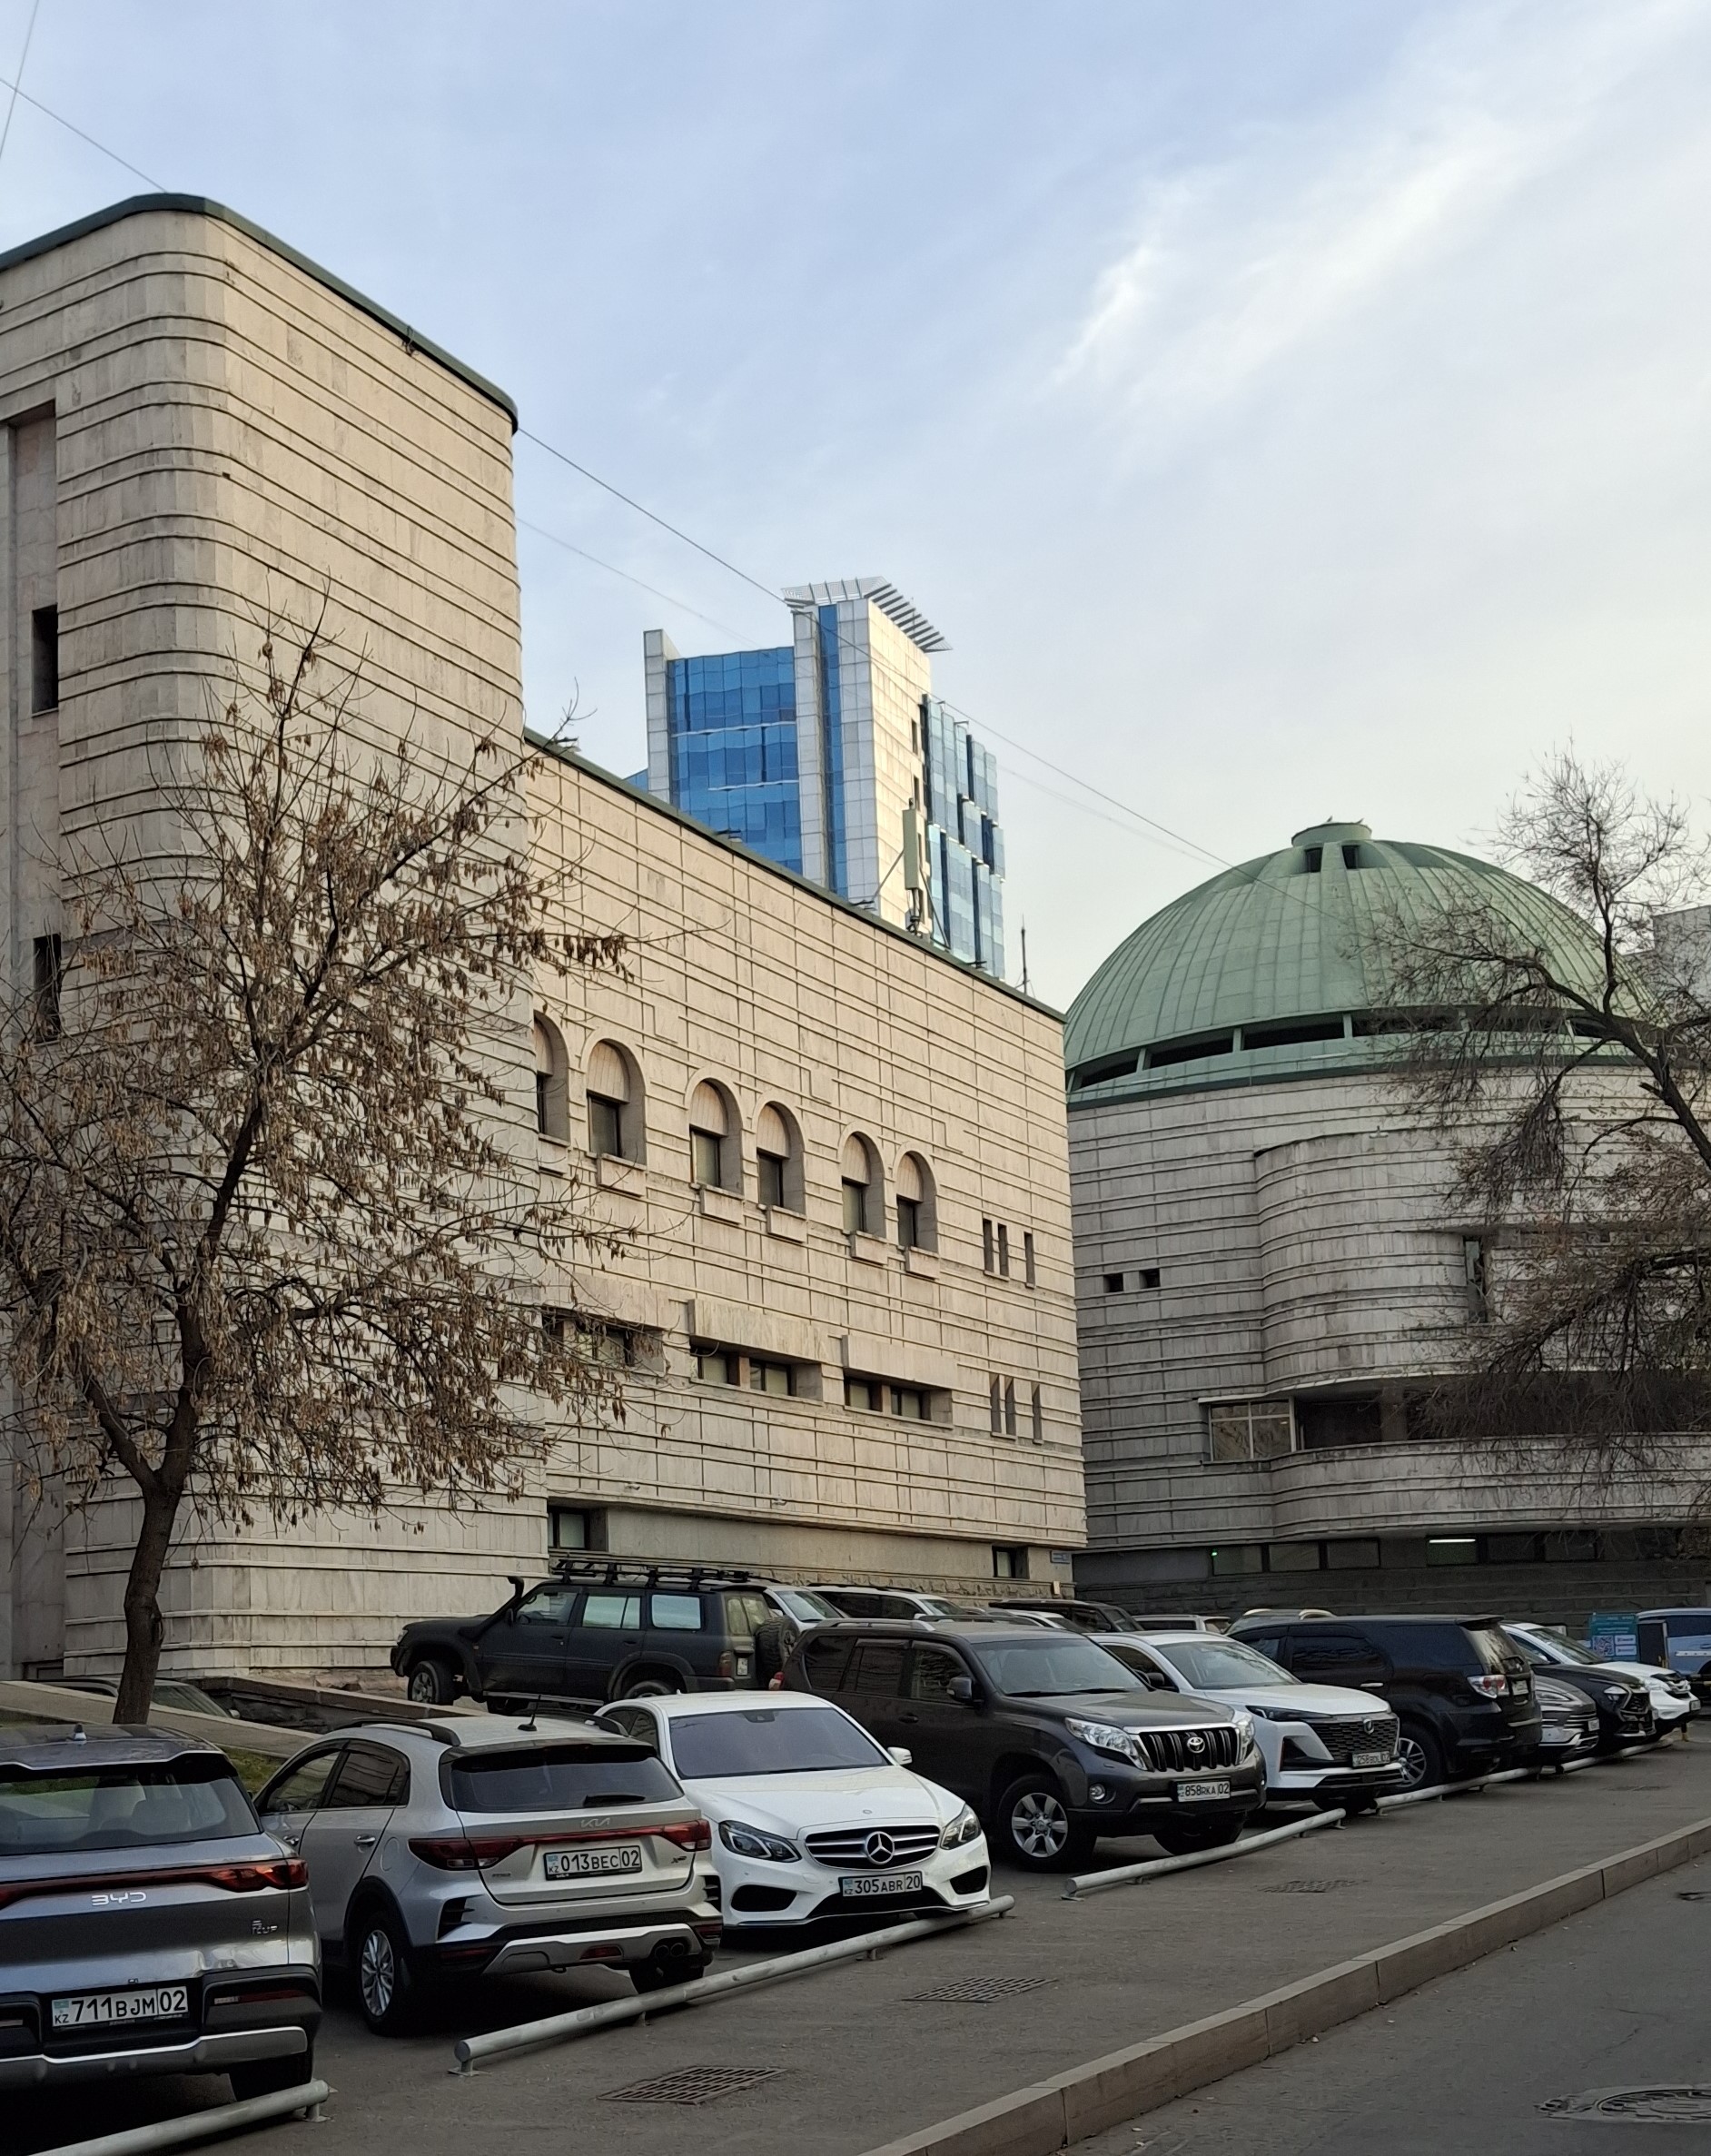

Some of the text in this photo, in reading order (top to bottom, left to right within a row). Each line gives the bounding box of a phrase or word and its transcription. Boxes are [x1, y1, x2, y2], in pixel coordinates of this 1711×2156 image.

[1218, 1783, 1230, 1795] 02
[580, 1817, 610, 1828] KIA
[549, 1850, 640, 1874] KZ 013BEC 02
[855, 1878, 904, 1894] 305ABR
[905, 1875, 921, 1890] 20
[92, 1892, 146, 1906] BYD
[54, 1990, 187, 2024] KZ 711BJM 02
